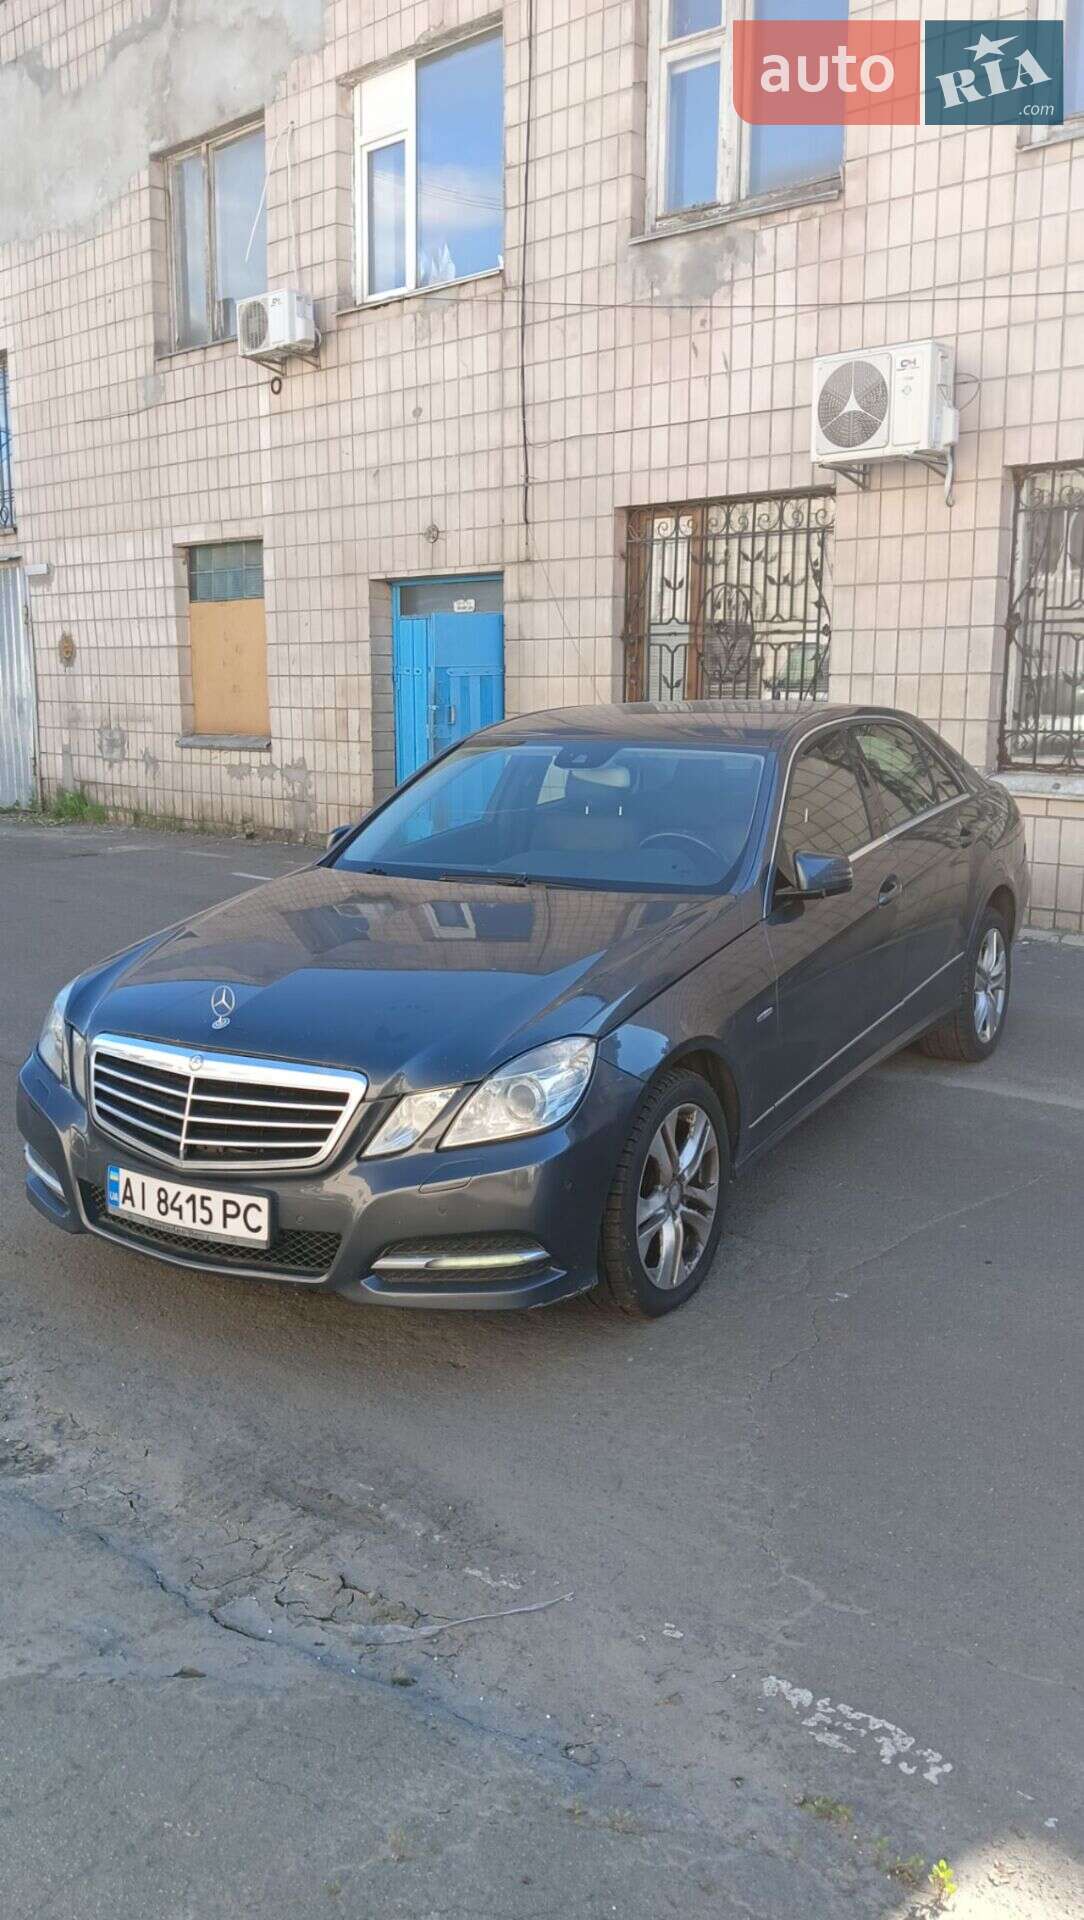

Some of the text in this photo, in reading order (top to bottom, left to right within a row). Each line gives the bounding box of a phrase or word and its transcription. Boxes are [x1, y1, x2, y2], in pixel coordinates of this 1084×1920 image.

[121, 1177, 146, 1211] AI
[156, 1187, 213, 1226] 8415
[222, 1199, 263, 1234] PC
